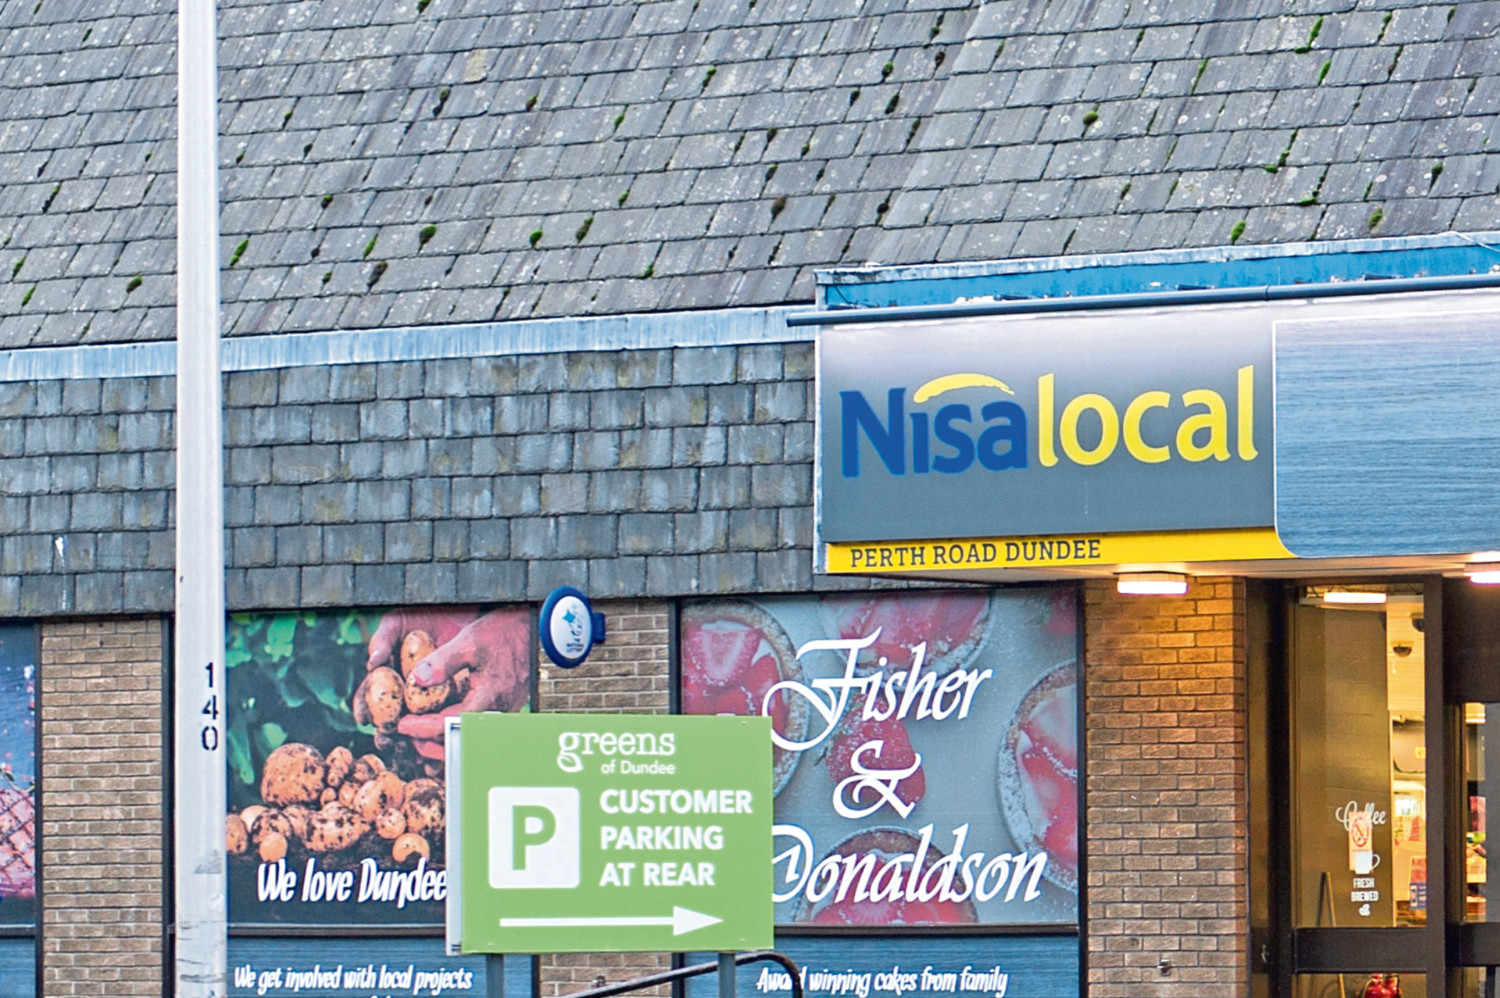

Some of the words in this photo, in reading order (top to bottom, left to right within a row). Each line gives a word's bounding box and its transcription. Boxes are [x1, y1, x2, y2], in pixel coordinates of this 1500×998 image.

[838, 373, 1029, 479] Nisa
[1036, 365, 1260, 468] local
[850, 546, 926, 568] PERTH
[933, 543, 997, 565] ROAD
[1005, 539, 1101, 561] DUNDEE
[762, 626, 993, 752] Fisher
[557, 731, 676, 773] greens
[601, 760, 616, 775] of
[621, 760, 676, 775] Dundee
[832, 740, 922, 820] &
[600, 789, 753, 814] CUSTOMER
[511, 805, 557, 871] P
[601, 825, 724, 850] PARKING
[599, 862, 635, 887] AT
[643, 862, 716, 887] REAR
[772, 823, 1048, 904] Donaldson
[257, 856, 297, 902] We
[301, 856, 353, 902] love
[357, 856, 447, 909] Dundee
[234, 963, 255, 989] We
[258, 967, 282, 996] get
[285, 963, 342, 992] involved
[343, 963, 376, 990] with
[378, 963, 413, 990] local
[413, 966, 473, 996] projects
[755, 966, 807, 992] Awad
[809, 968, 871, 998] winning
[873, 965, 918, 996] cakes
[920, 965, 957, 993] from
[959, 965, 1008, 998] family
